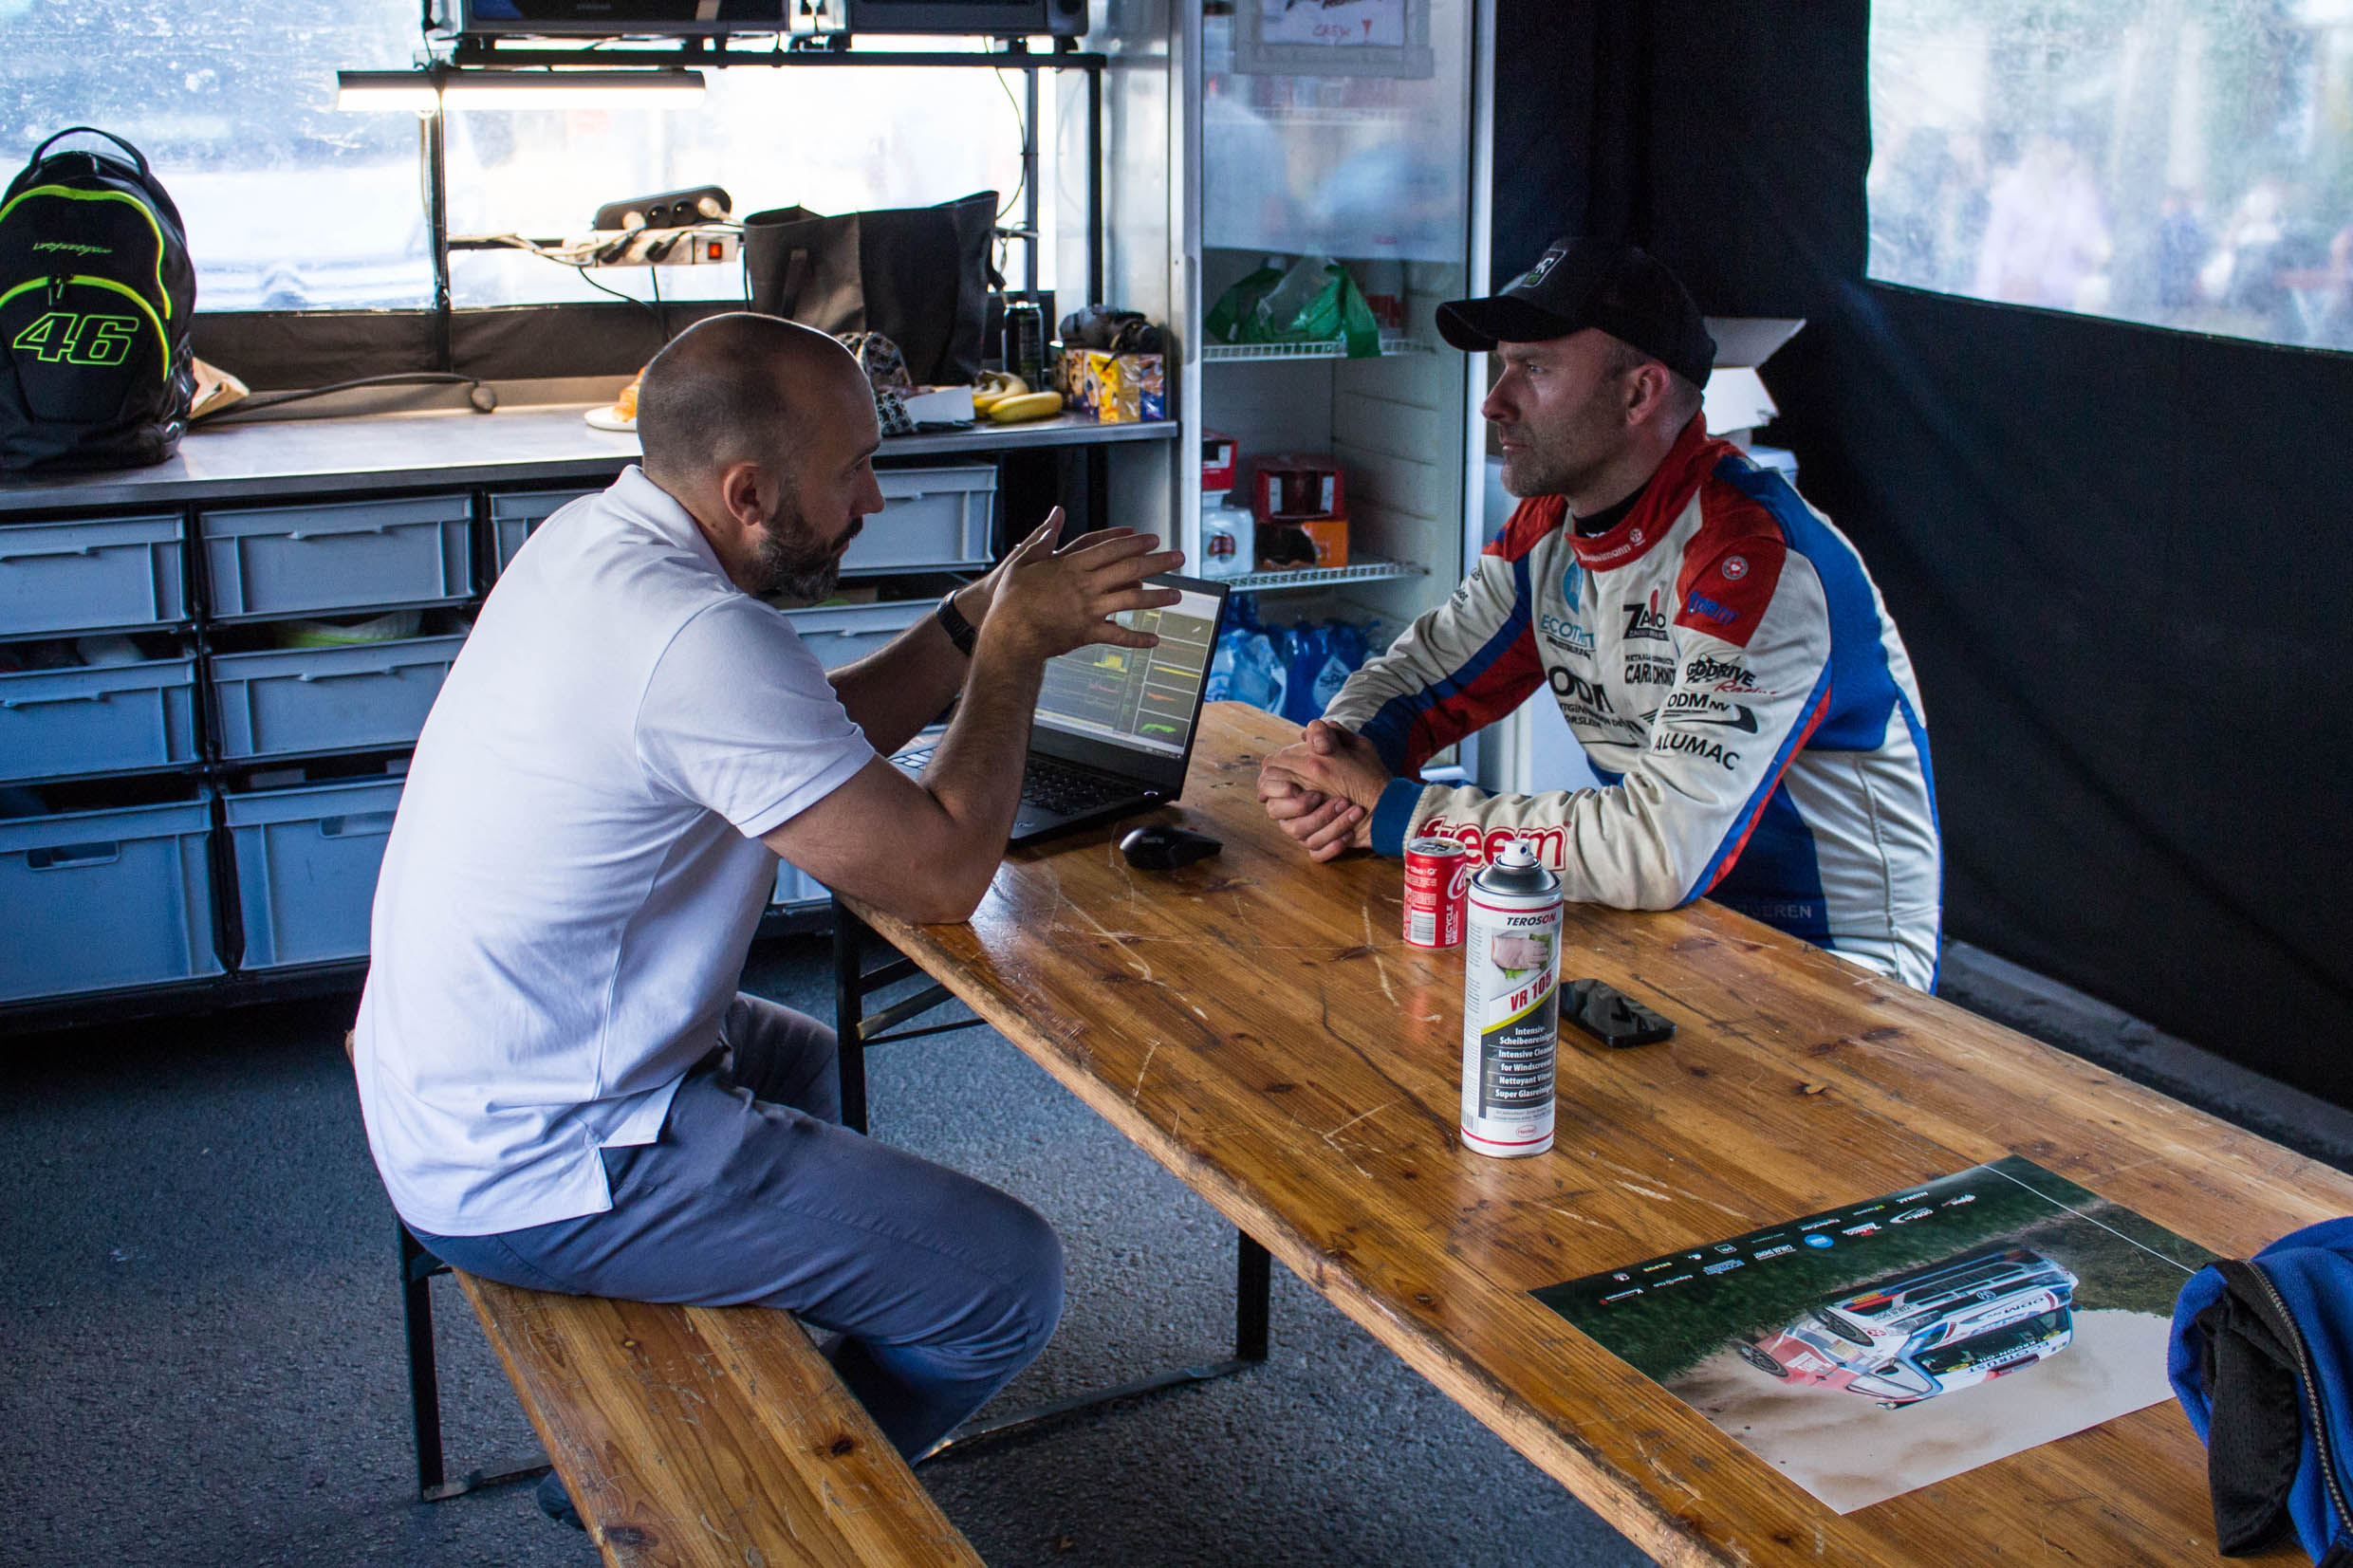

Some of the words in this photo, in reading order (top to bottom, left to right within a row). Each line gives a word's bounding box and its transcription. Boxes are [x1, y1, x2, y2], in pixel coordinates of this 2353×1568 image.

[12, 311, 139, 366] 46
[1667, 692, 1710, 709] ODM
[1709, 700, 1730, 712] NV
[1653, 732, 1740, 771] ALUMAC
[1416, 816, 1567, 871] feem
[1445, 904, 1454, 945] RECYCLE
[1506, 912, 1556, 926] TEROSON
[1510, 989, 1528, 1012] VR
[1498, 1049, 1533, 1059] Intensive
[1501, 1062, 1512, 1072] for
[1499, 1076, 1537, 1087] Nettoyant
[1495, 1089, 1518, 1099] Super
[1967, 1341, 2049, 1373] ECOTRUST
